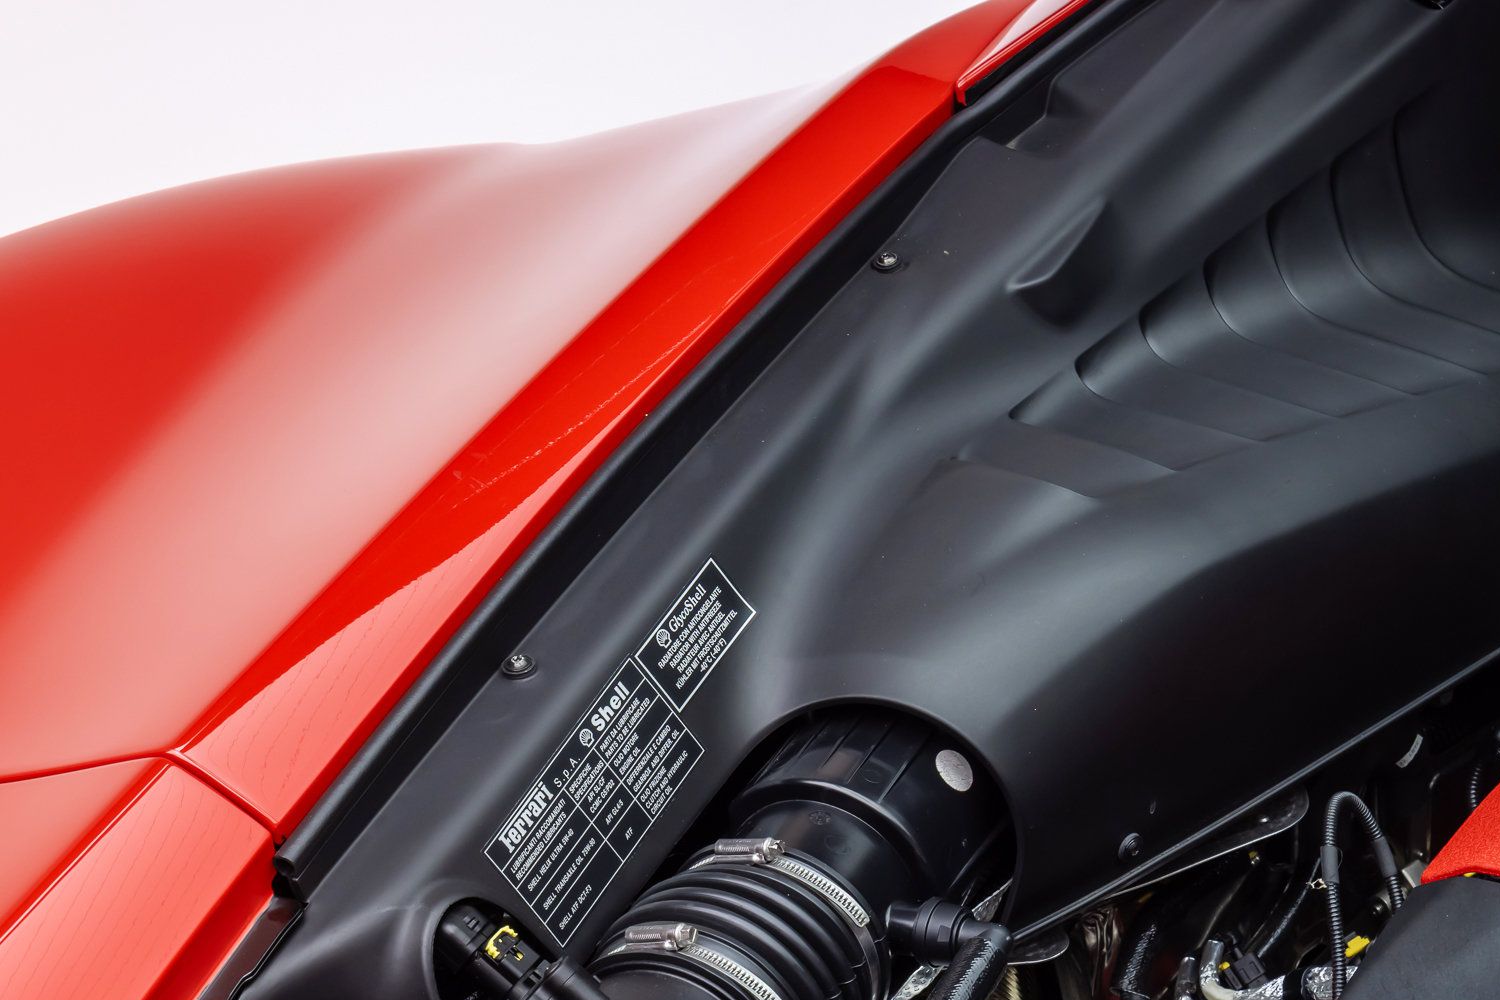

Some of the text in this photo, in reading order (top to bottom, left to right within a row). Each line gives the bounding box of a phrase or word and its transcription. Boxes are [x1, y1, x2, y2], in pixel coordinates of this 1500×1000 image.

[657, 585, 722, 670] RADIATORE CON ANTICONGELANTE
[668, 583, 707, 633] GlycoShell
[669, 600, 722, 669] RADIATOR WITH ANTIFREEZE
[675, 609, 738, 690] KÜHLER MIT FROSTSCHUTZMITTEL
[676, 611, 726, 674] RADIATEUR AVEC ANTIGEL
[599, 697, 641, 753] PARTI DA LUBRIFICARE
[604, 697, 651, 759] PARTS TO BE LUBRICATED
[613, 731, 640, 767] OLIO MOTORE
[626, 724, 671, 786] DIFFERENZIALE E CAMBIO
[497, 680, 630, 854] Ferrari S.p.A. Shell
[568, 762, 592, 794] SPECIFICHE
[573, 759, 605, 801] SPECIFICATIONS
[618, 746, 641, 776] ENGINE OIL
[632, 729, 680, 793] GEARBOX AND DIFFER. OIL
[640, 765, 667, 803] OLIO FRIZIONE
[645, 750, 689, 809] CLUTCH AND HYDRAULIC
[650, 785, 673, 815] CIRCUIT OIL
[510, 798, 566, 874] LUBRIFICANTI RACCOMANDATI
[515, 811, 567, 881] RECOMMENDED LUBRICANTS
[527, 828, 574, 892] SHELL HELIX ULTRA 5W-40
[624, 826, 633, 841] ATF
